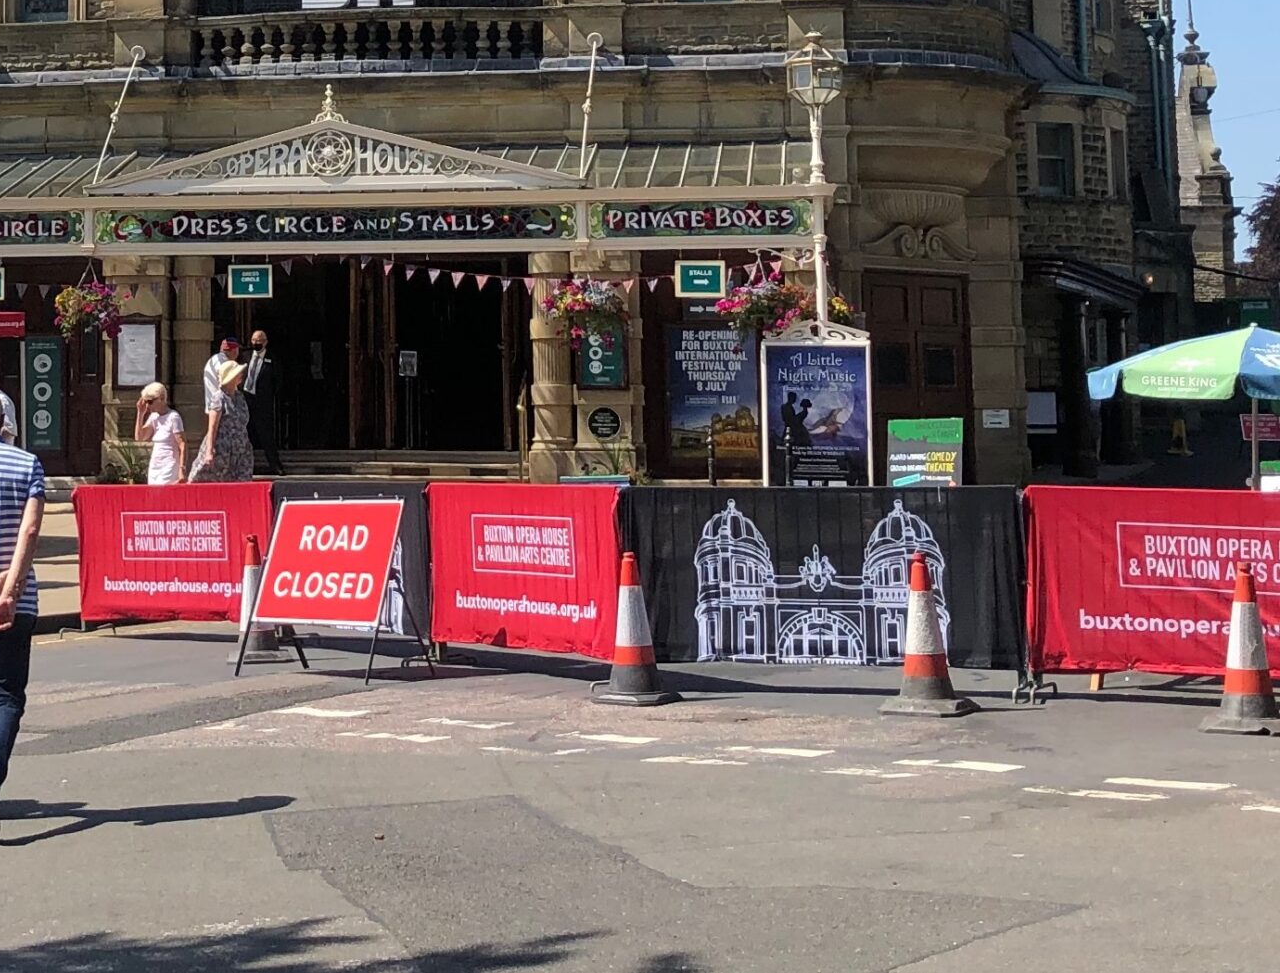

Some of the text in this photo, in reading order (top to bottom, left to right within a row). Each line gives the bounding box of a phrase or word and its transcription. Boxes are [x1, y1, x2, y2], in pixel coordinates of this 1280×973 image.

[226, 137, 435, 177] OPERA HOUSE
[172, 213, 495, 236] DRESS CIRCLE AND STALLS
[608, 207, 794, 229] PRIVATE BOXES
[682, 330, 740, 340] RE-OPENING
[681, 340, 739, 350] FOR BUXTO
[675, 350, 748, 360] INTERNATIONAL
[789, 352, 843, 367] A Little
[682, 361, 741, 371] FESTIVAL ON
[687, 371, 736, 381] THURSDAY
[778, 368, 857, 384] Night Music
[1141, 375, 1217, 388] GREENE KING
[697, 381, 727, 391] 8 JULY
[926, 451, 957, 462] COMEDY
[925, 462, 955, 473] THEATRE
[133, 520, 222, 535] BUXTON OPERA HOUSE
[483, 524, 569, 546] BUXTON OPERA HOUSE
[127, 537, 223, 552] & PAVILION ARTS CENTRE
[298, 524, 369, 551] ROAD
[1144, 534, 1274, 560] BUXTON OPERA
[477, 545, 571, 567] & PAVILION ARTS CENTRE
[1128, 558, 1141, 577] &
[1146, 557, 1220, 581] PAVILION
[1225, 561, 1268, 584] ATS
[104, 576, 244, 598] buxtonoperahouse.org.u
[272, 571, 375, 600] CLOSED
[455, 589, 598, 623] buxtonoperahouse.org.uk
